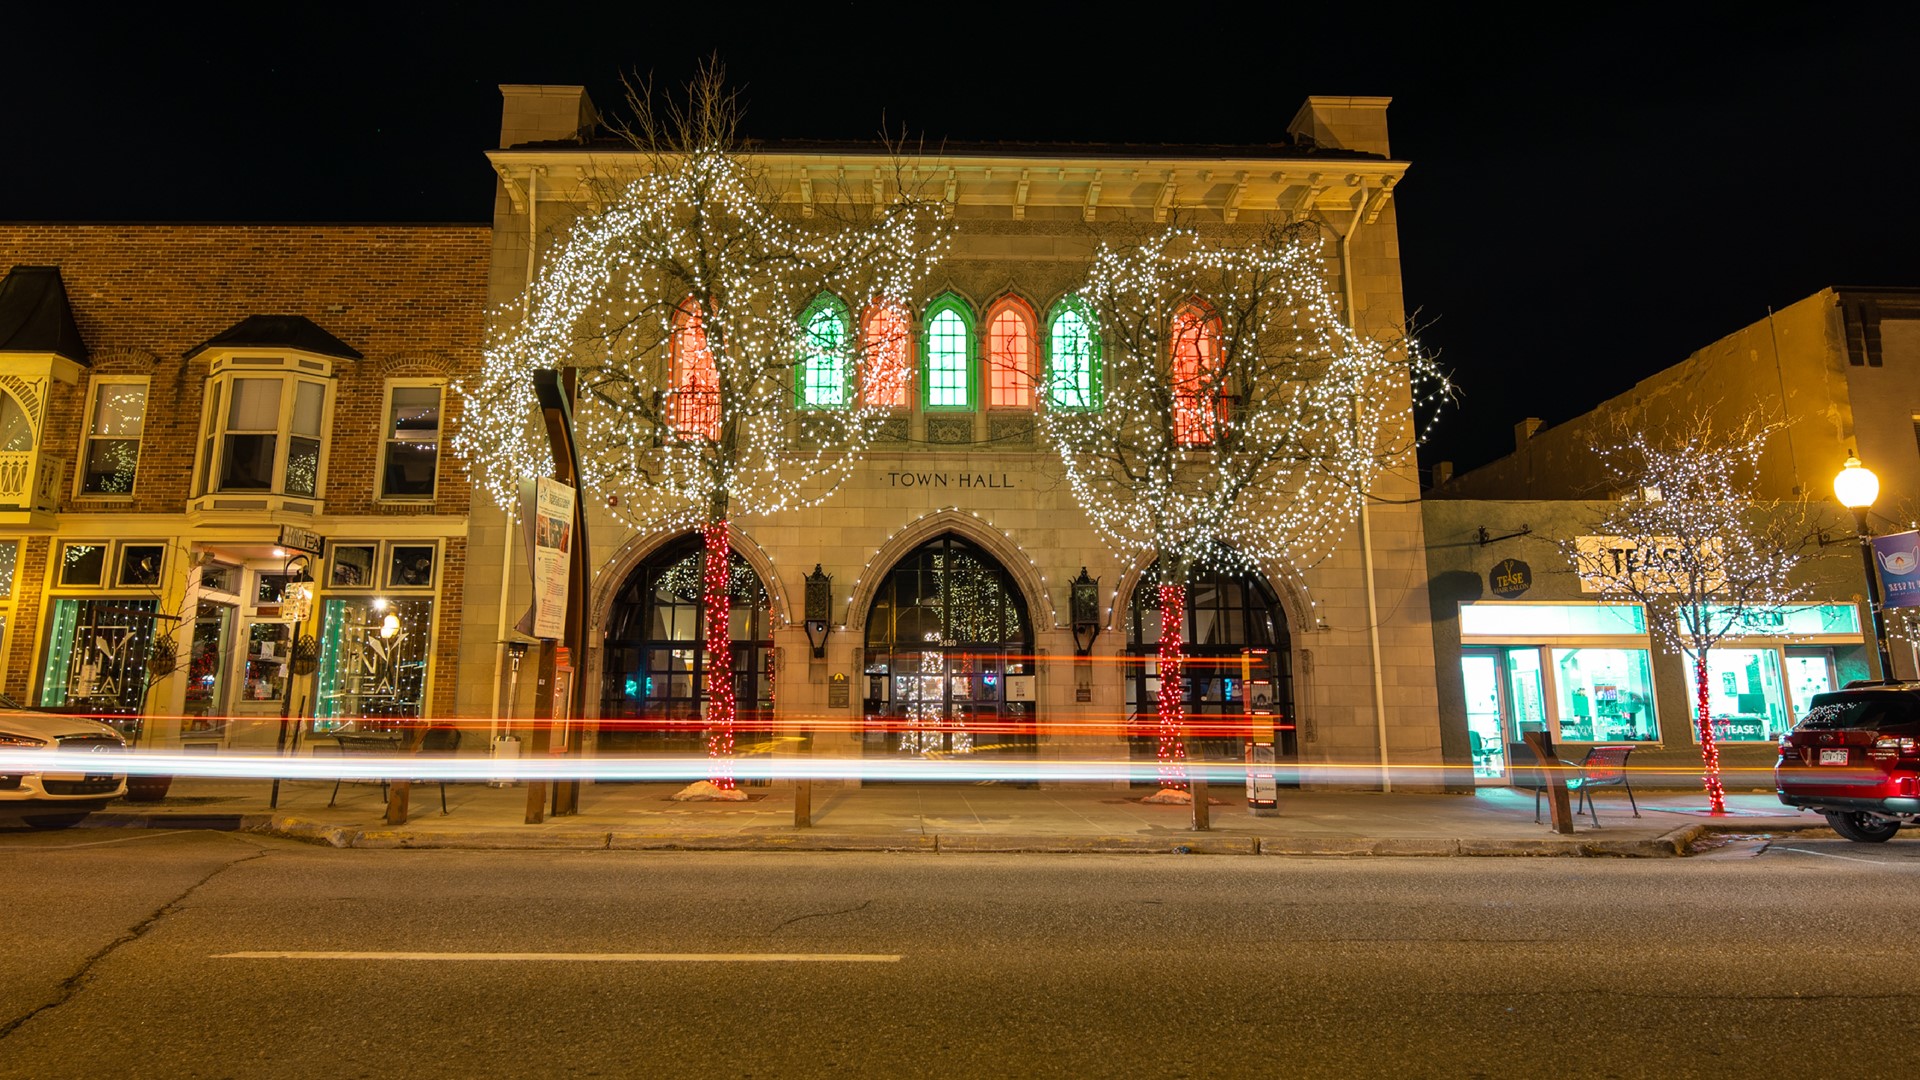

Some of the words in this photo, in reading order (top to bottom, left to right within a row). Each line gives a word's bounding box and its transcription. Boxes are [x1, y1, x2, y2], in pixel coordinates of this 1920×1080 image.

[888, 472, 947, 487] TOWN
[959, 473, 1015, 488] HALL
[304, 534, 319, 550] TEA
[1497, 572, 1524, 588] TEASE
[1509, 583, 1529, 592] SALON
[1726, 724, 1755, 735] TEASE
